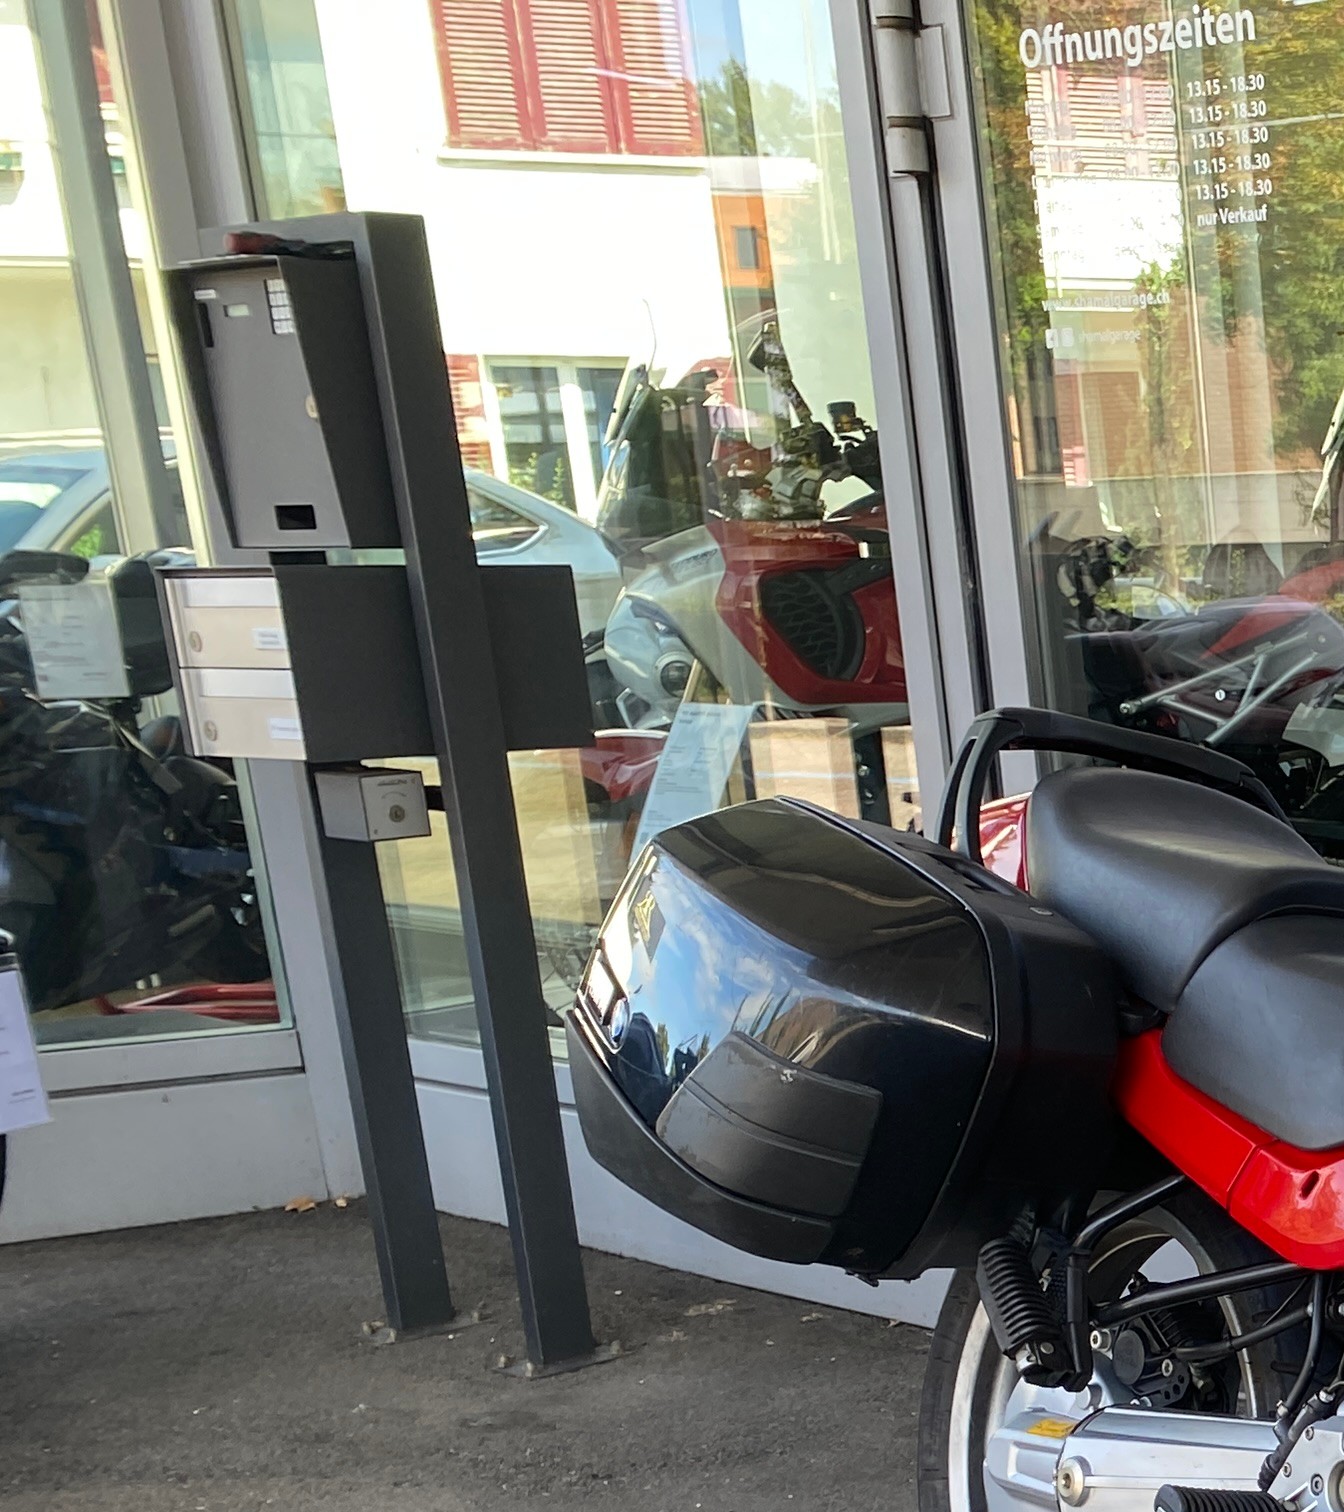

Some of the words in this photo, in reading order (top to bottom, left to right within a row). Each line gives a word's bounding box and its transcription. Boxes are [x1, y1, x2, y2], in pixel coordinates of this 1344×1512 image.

[1187, 79, 1221, 97] 13.15
[1230, 74, 1265, 92] 18.30
[1190, 105, 1223, 123] 13.15
[1232, 100, 1267, 118] 18.30
[1192, 131, 1225, 149] 13.15
[1234, 126, 1269, 144] 18.30
[1193, 157, 1226, 175] 13.15
[1236, 152, 1271, 171] 18.30
[1196, 182, 1229, 200] 13.15
[1238, 178, 1272, 197] 18.30
[1197, 212, 1218, 227] nur
[1218, 203, 1268, 224] Verkauf
